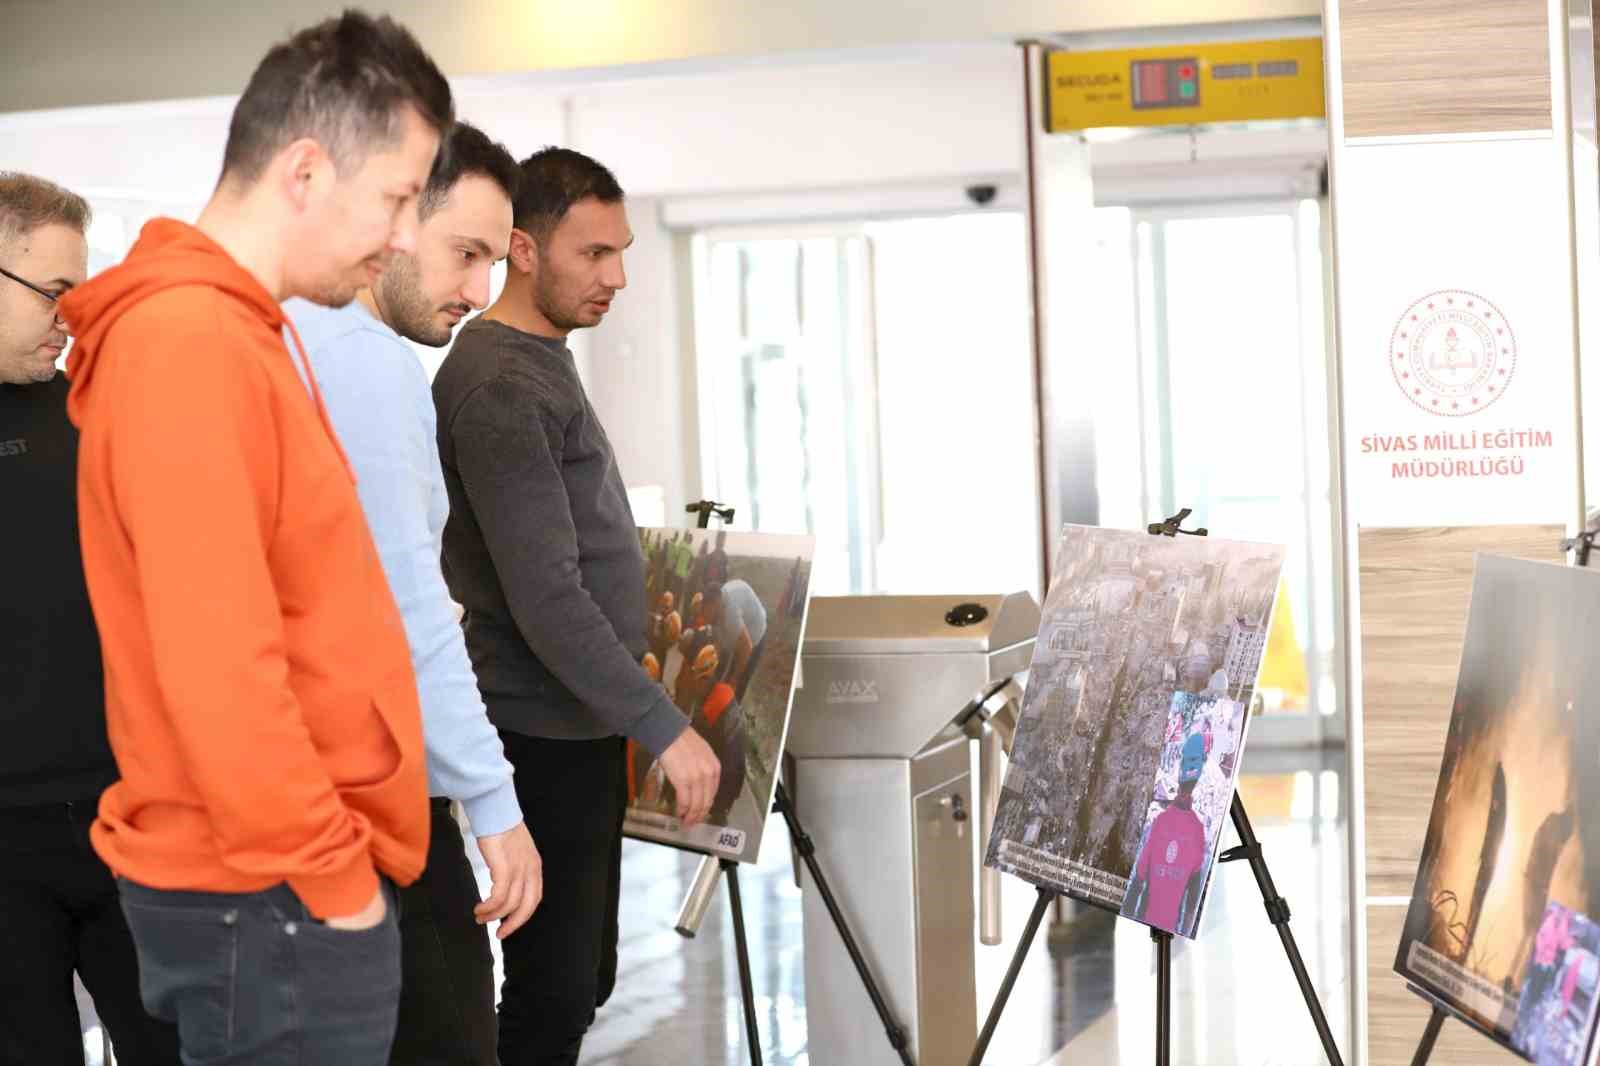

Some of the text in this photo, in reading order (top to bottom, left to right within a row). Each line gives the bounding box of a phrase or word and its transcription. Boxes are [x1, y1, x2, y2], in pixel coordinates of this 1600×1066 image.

[1361, 428, 1553, 453] SİVAS MİLLİ EĞİTİM
[1391, 456, 1524, 479] MÜDÜRLÜĞÜ
[827, 679, 878, 696] AVAX
